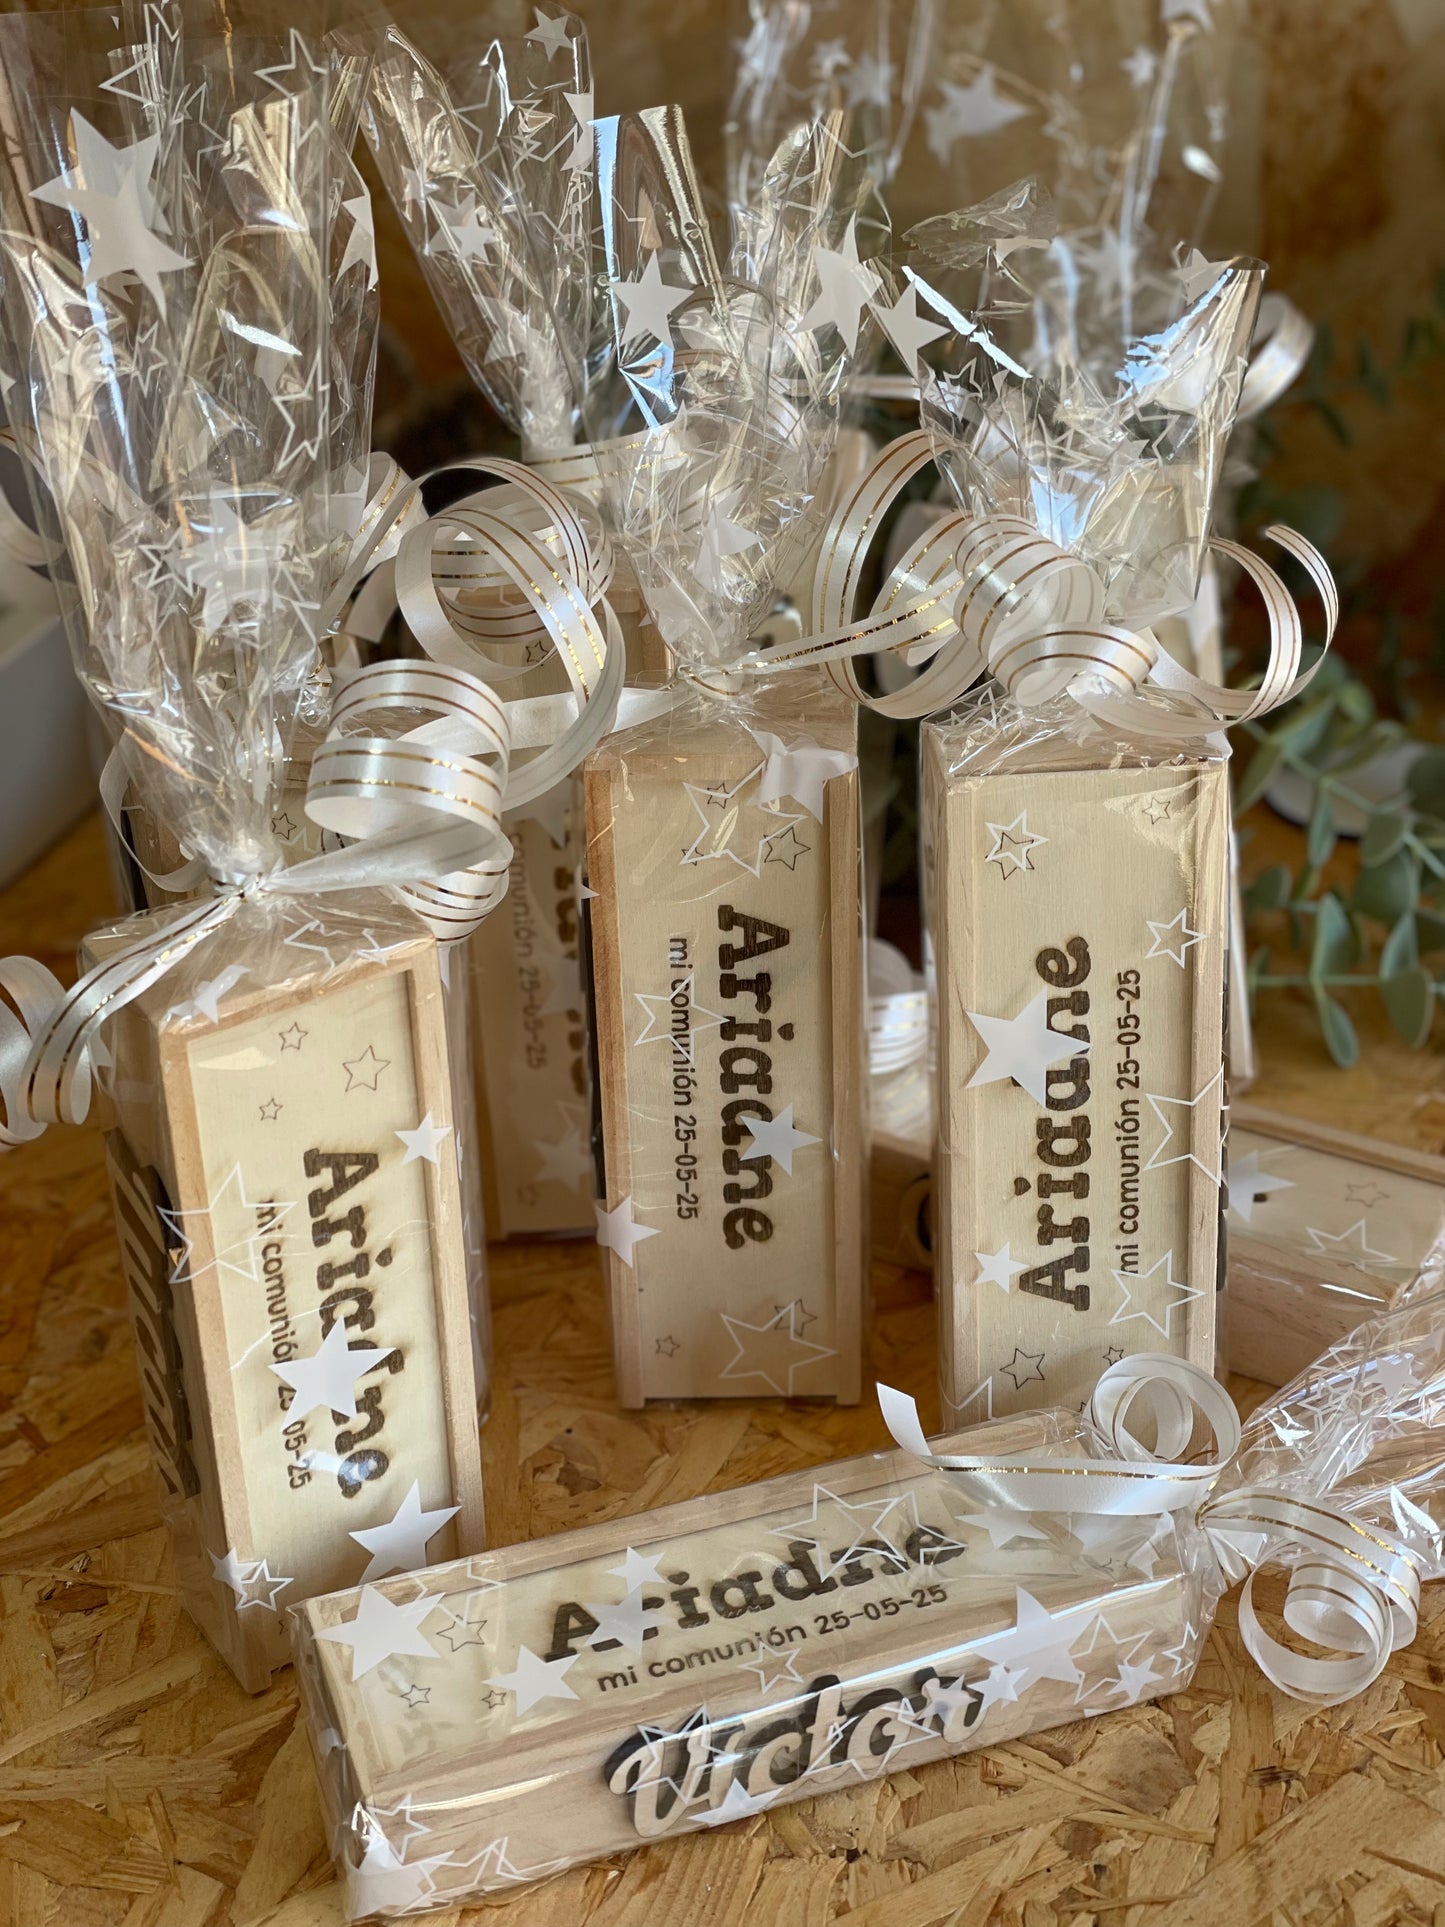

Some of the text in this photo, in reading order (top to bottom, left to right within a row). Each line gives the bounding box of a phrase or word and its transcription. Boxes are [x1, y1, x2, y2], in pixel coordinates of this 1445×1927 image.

[669, 937, 699, 1221] mi comunión 25-05-25
[1115, 968, 1142, 1275] mi comunión 25-05-25
[256, 1199, 284, 1235] mi
[261, 1243, 299, 1368] comunió
[597, 1584, 949, 1692] mi comunión 25-05-25
